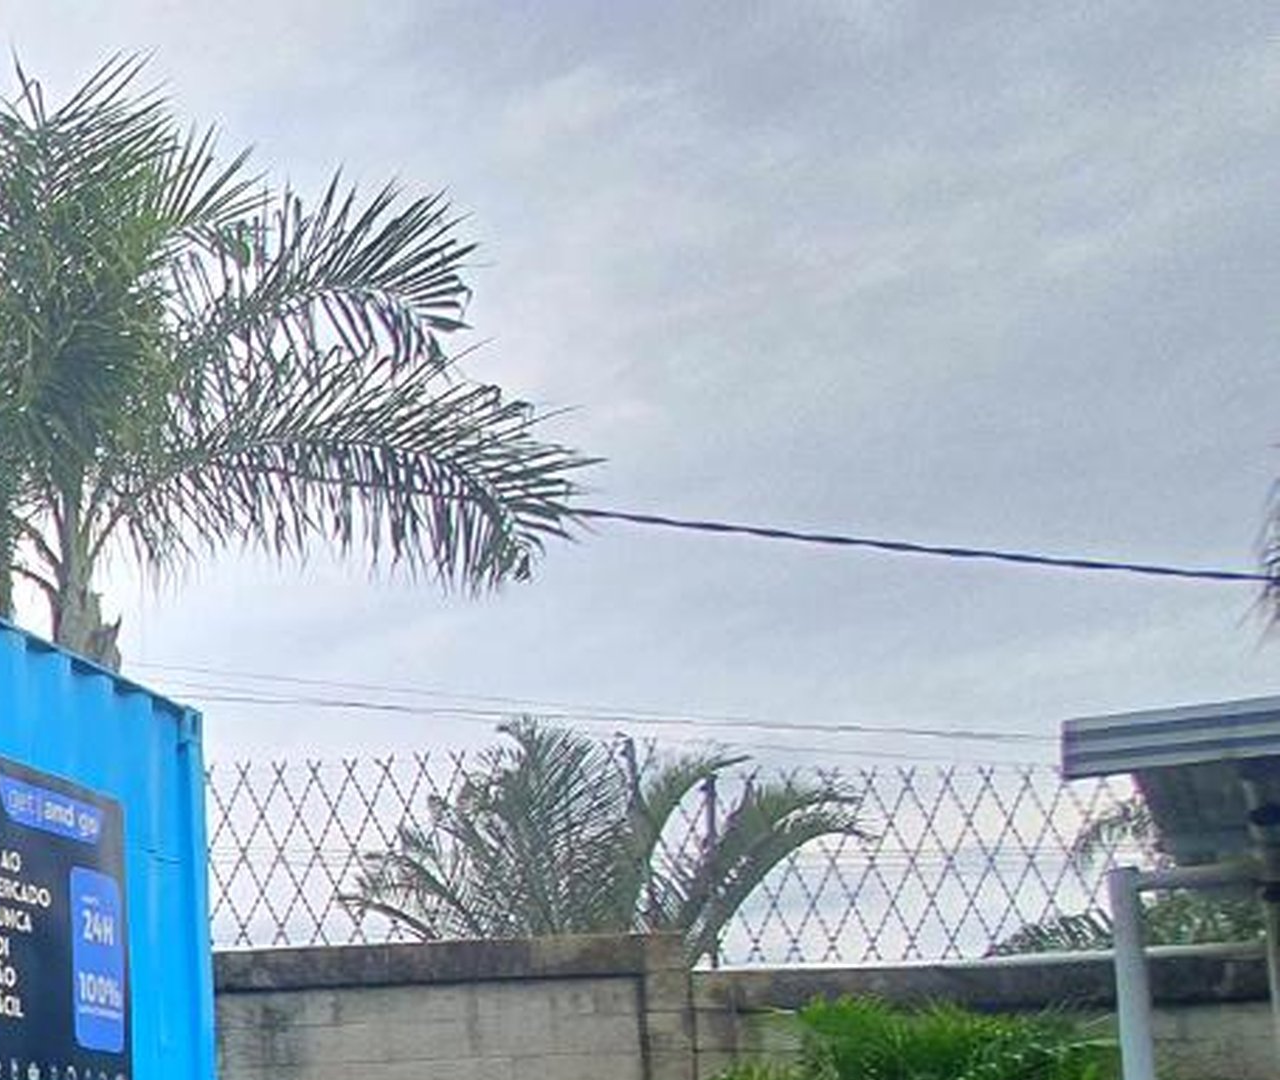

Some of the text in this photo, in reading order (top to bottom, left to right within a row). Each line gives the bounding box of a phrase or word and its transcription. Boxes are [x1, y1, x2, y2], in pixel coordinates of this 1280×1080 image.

[43, 801, 75, 829] and
[78, 812, 99, 837] go
[0, 850, 22, 873] AO
[82, 909, 114, 946] 24H
[77, 970, 122, 1008] 100%
